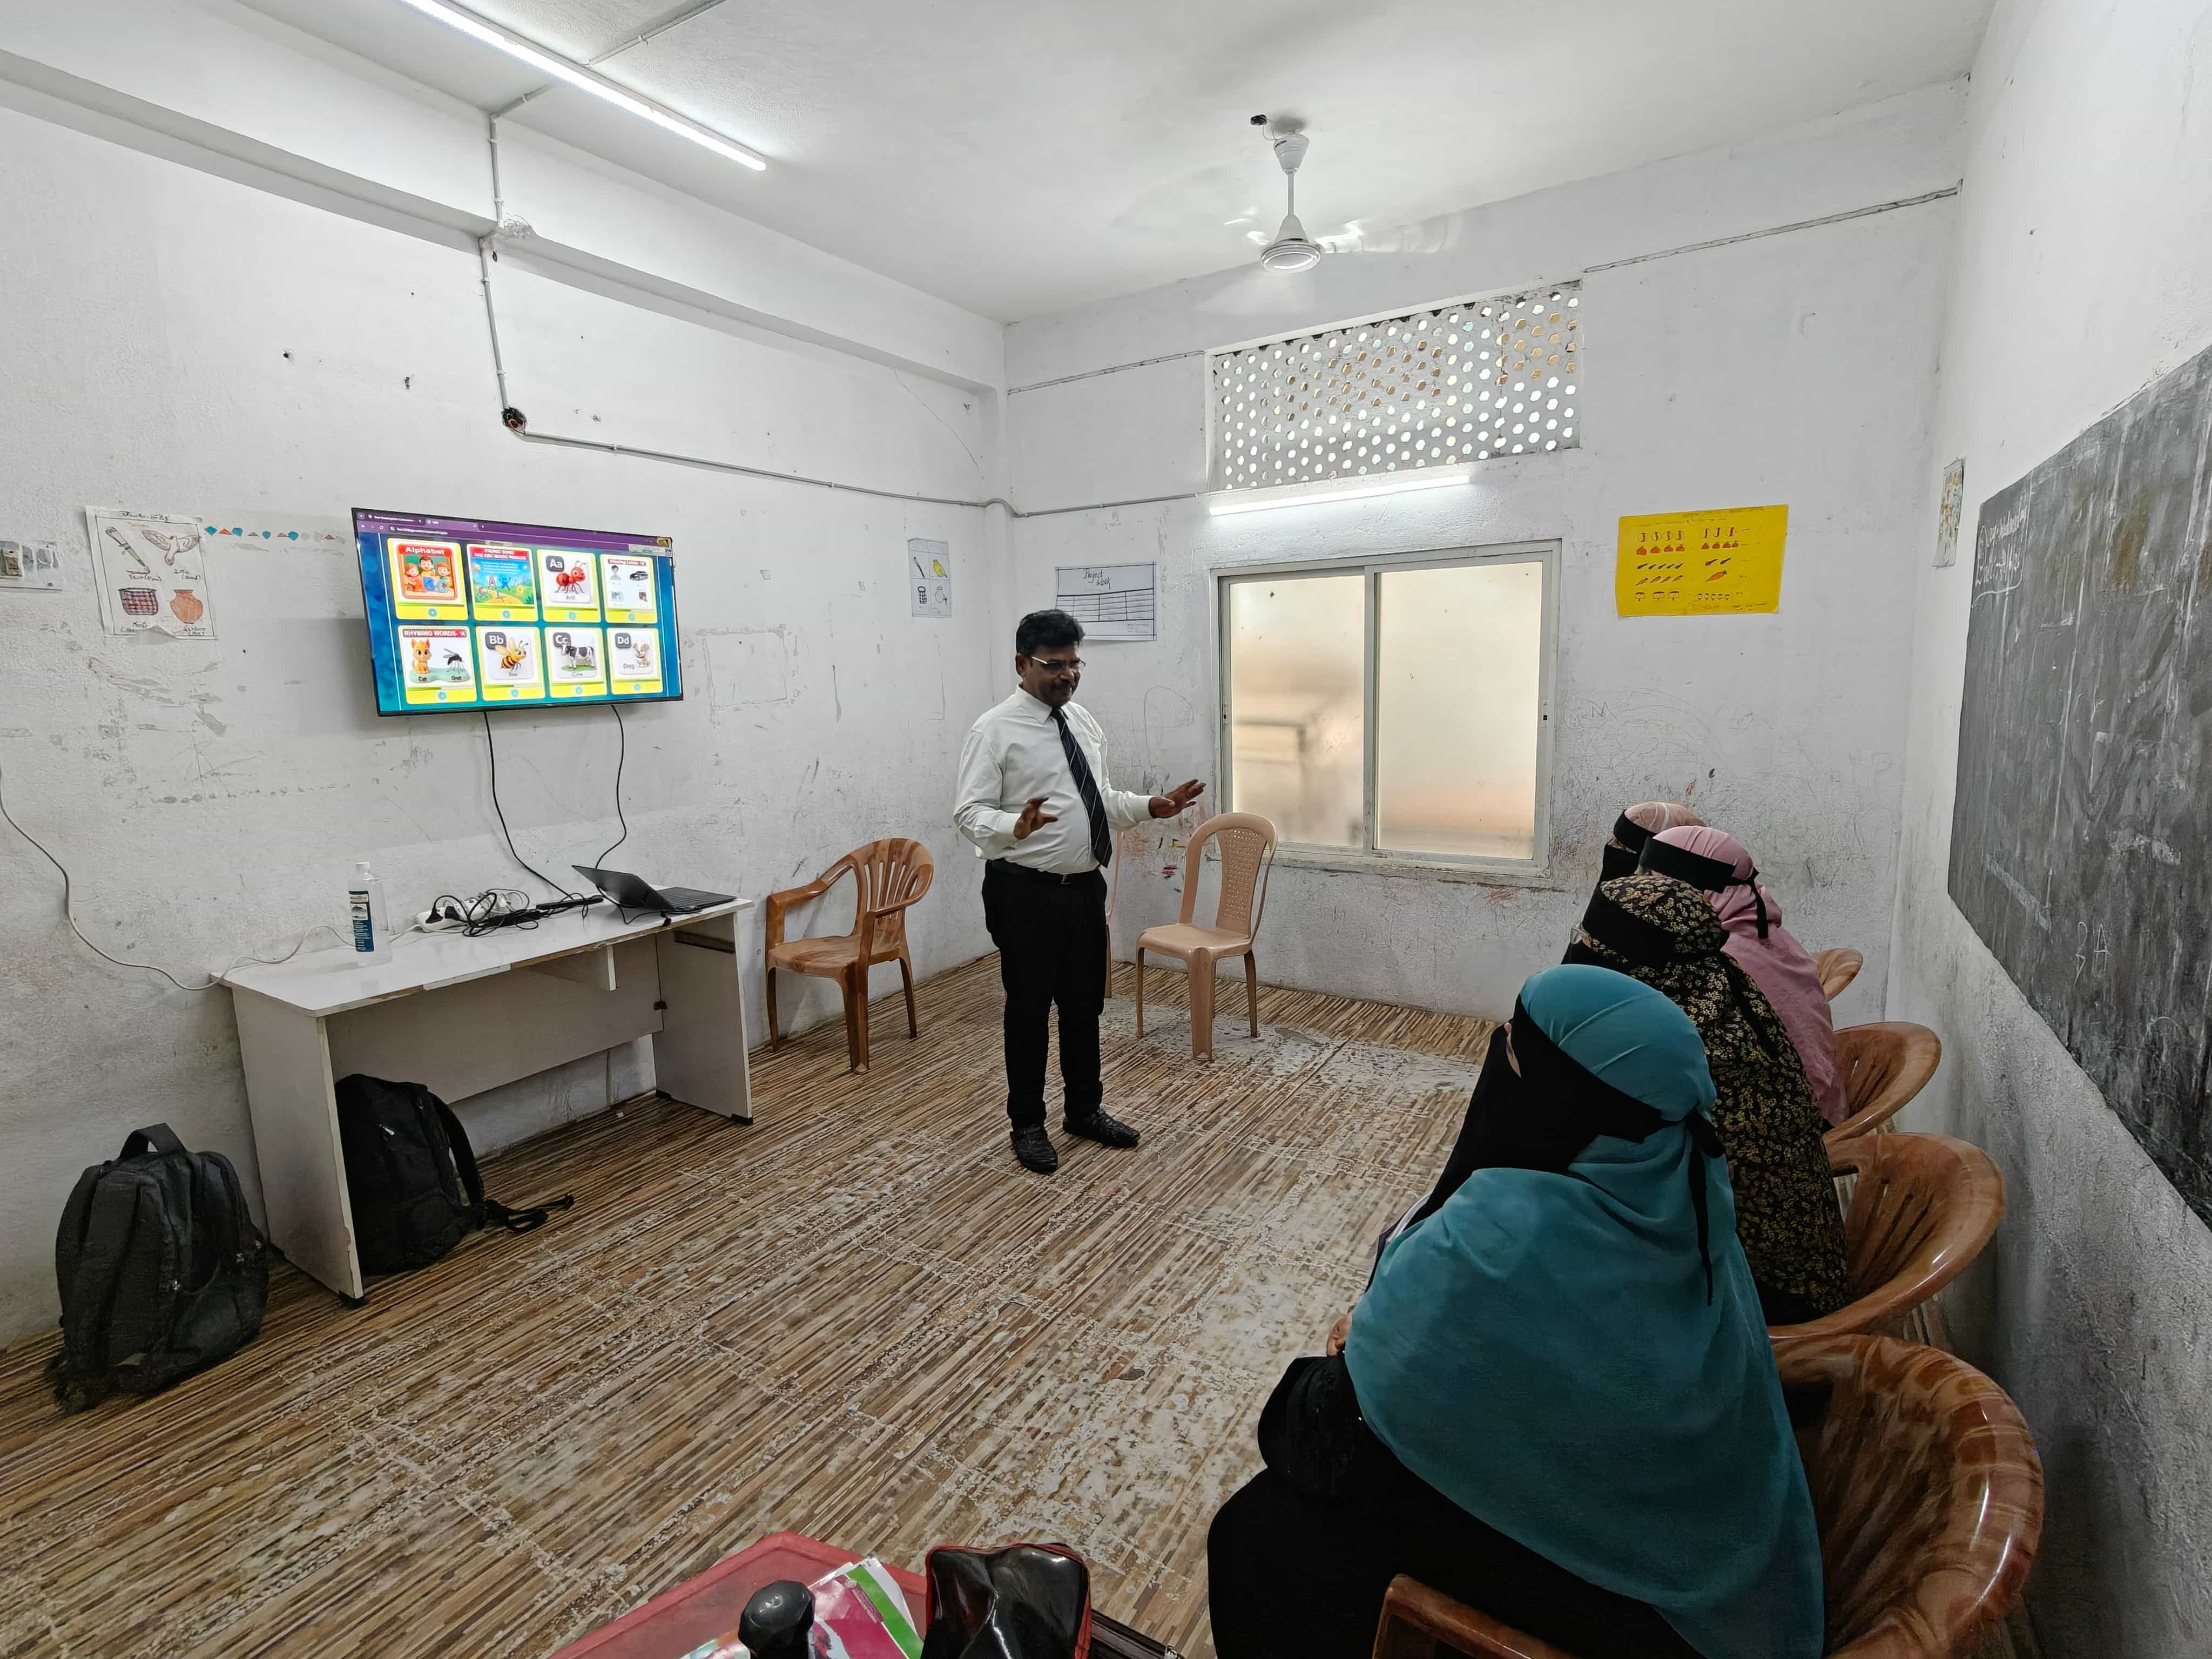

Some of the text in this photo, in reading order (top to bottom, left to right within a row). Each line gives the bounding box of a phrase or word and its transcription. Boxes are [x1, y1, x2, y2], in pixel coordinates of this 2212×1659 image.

[406, 547, 445, 555] Alphabet
[489, 635, 504, 644] Bb
[555, 635, 569, 644] Cc
[617, 636, 630, 644] Dd
